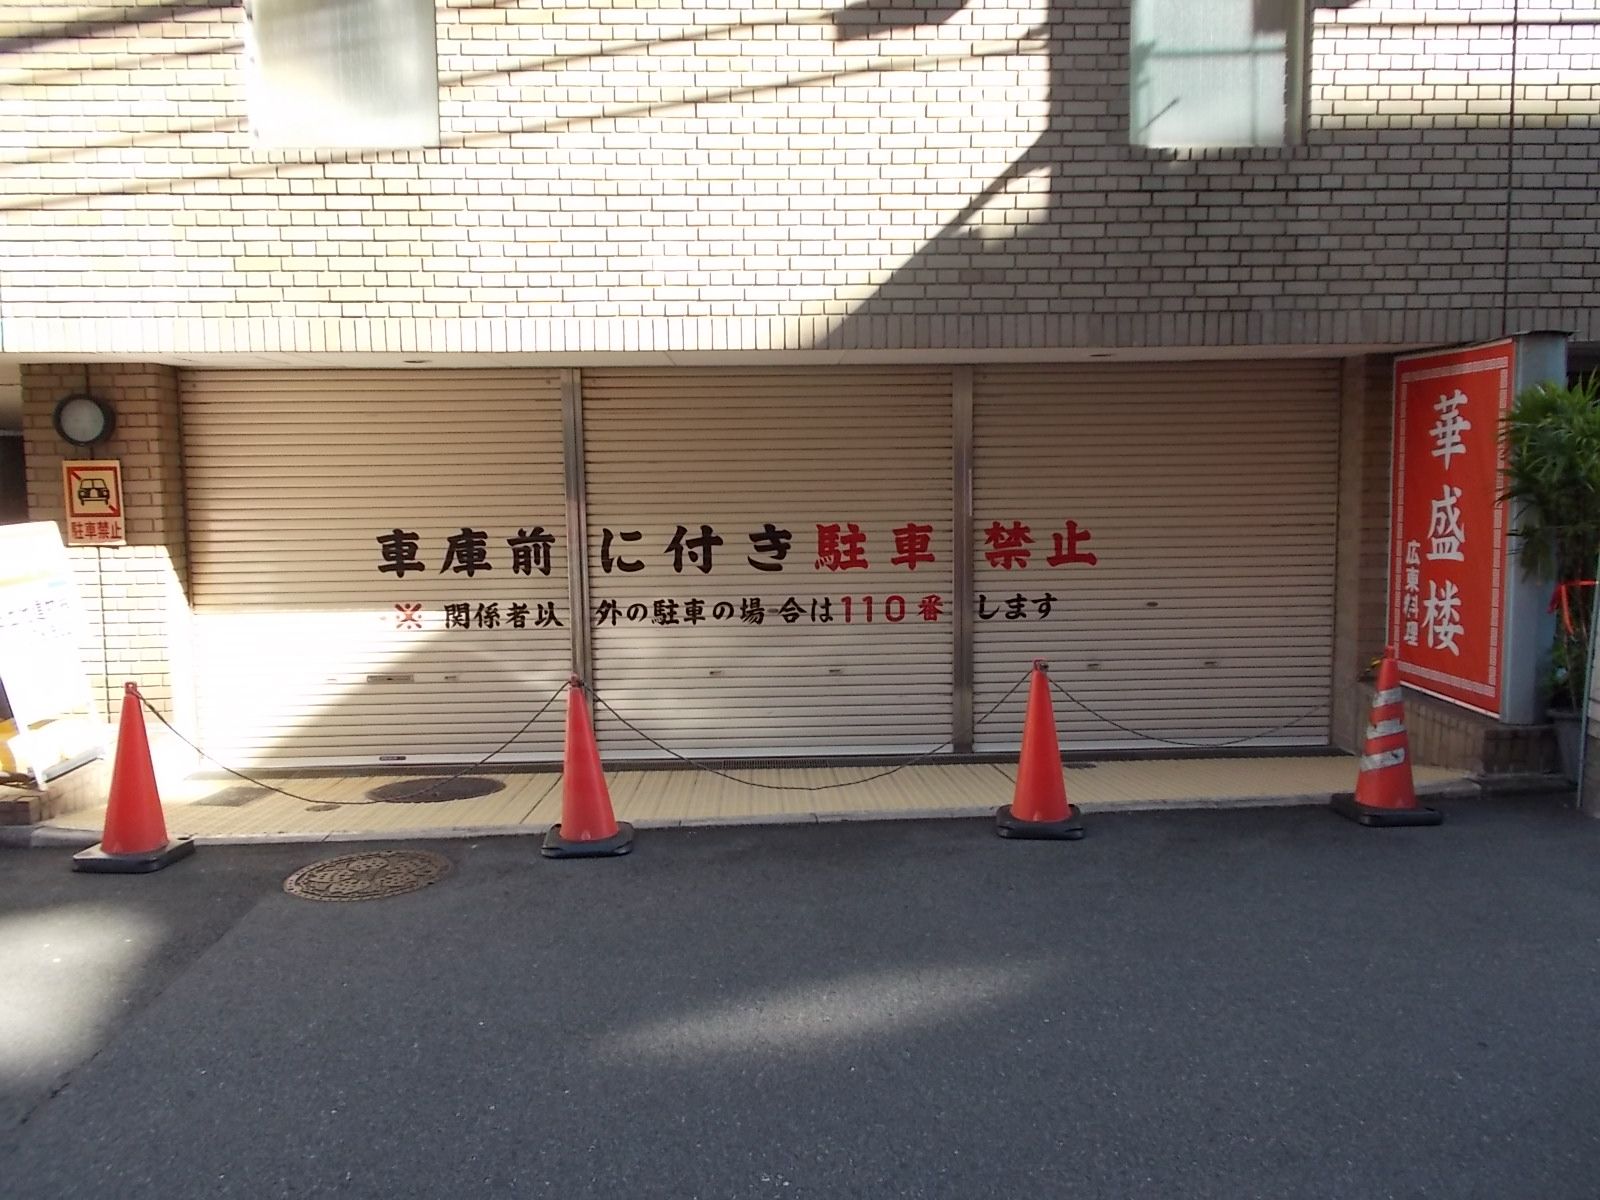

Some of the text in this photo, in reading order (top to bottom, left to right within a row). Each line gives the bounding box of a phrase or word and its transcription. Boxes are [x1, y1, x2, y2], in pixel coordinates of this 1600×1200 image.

[71, 521, 122, 540] 駐車禁止
[1422, 388, 1471, 656] 華盛楼
